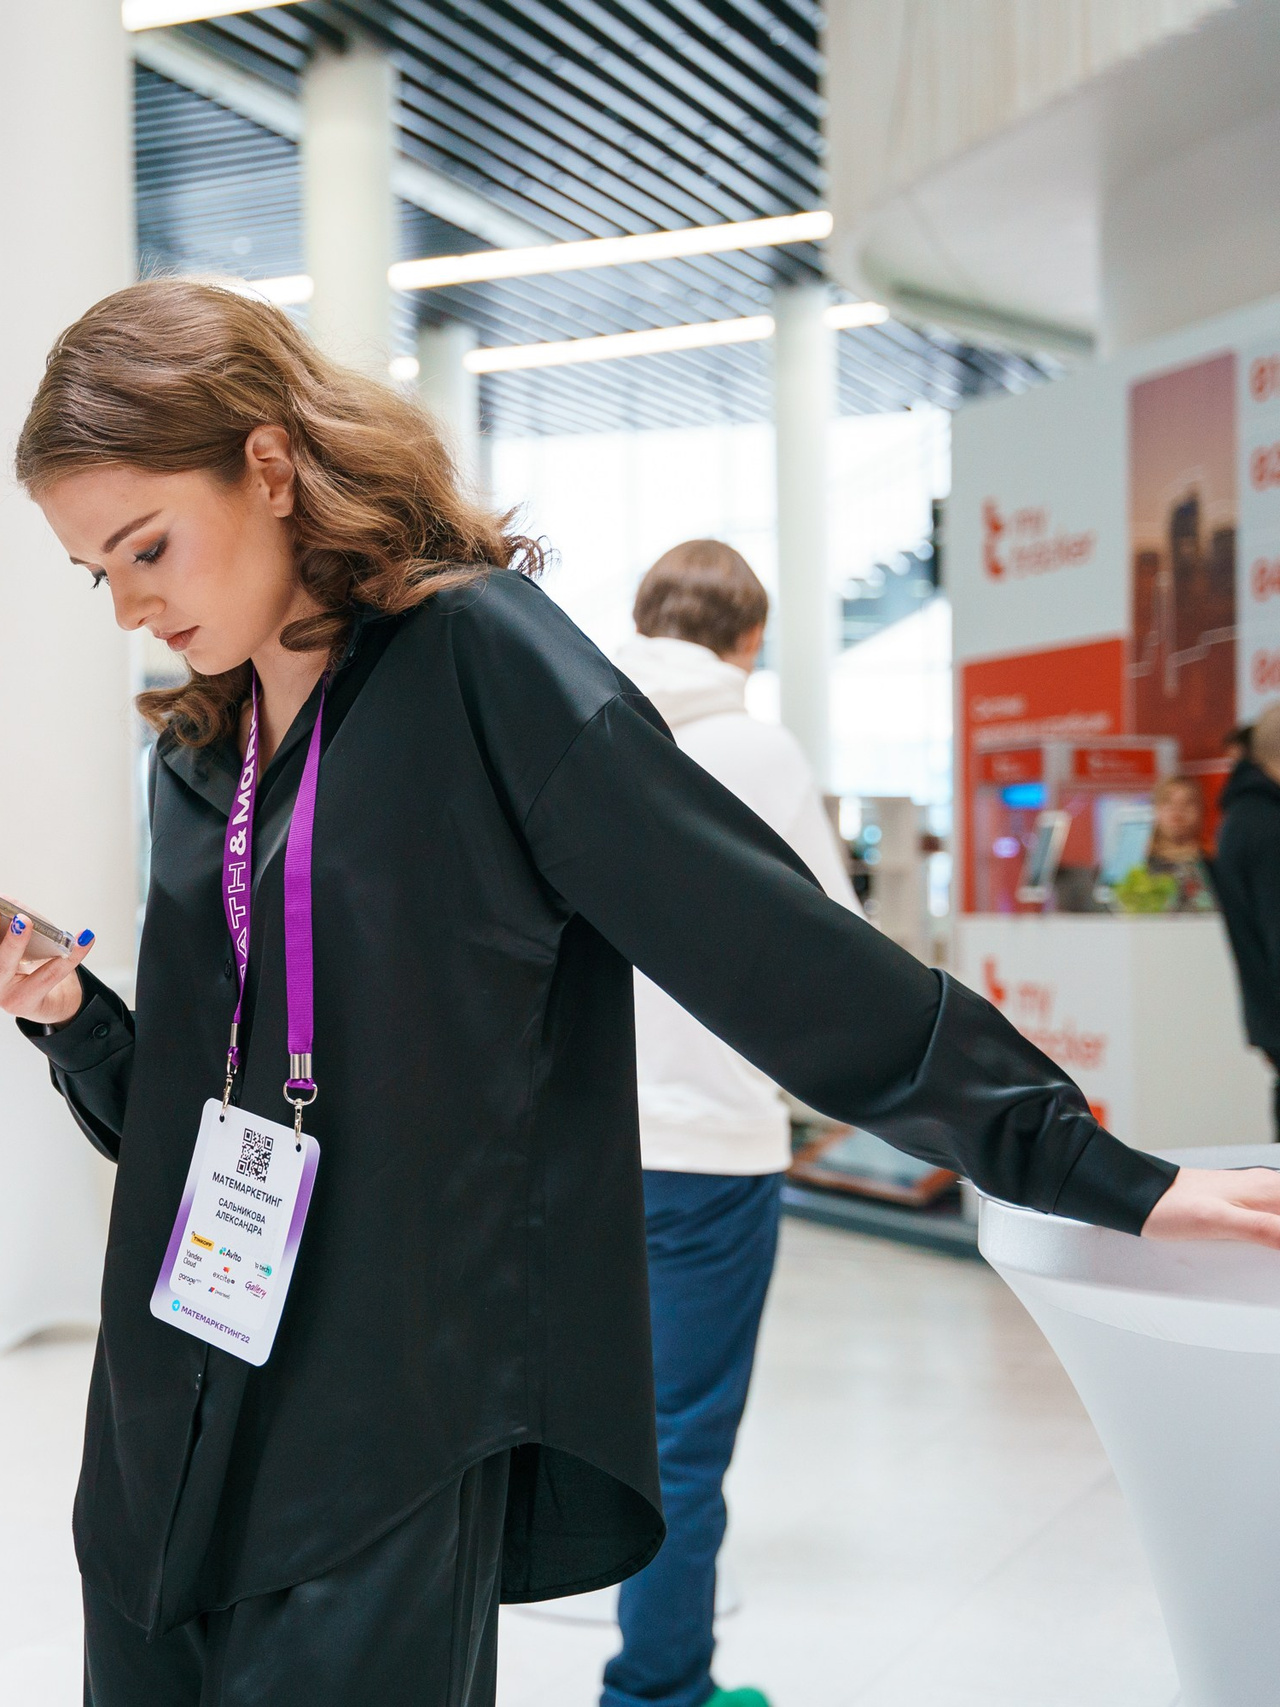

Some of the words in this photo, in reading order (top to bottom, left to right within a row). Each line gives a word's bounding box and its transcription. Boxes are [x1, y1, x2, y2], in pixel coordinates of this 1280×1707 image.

[229, 827, 247, 856] &
[211, 1171, 283, 1208] МАТЕМАРКЕТИНГ
[215, 1209, 263, 1237] АЛЕКСАНДРА
[218, 1197, 266, 1225] САЛЬНИКОВА
[182, 1256, 197, 1269] Cloud
[186, 1249, 203, 1263] Yandex
[225, 1248, 243, 1263] Avito
[212, 1271, 231, 1285] excite
[244, 1280, 268, 1300] Gallery
[181, 1305, 251, 1344] МАТЕМАРКЕТИНГ22
